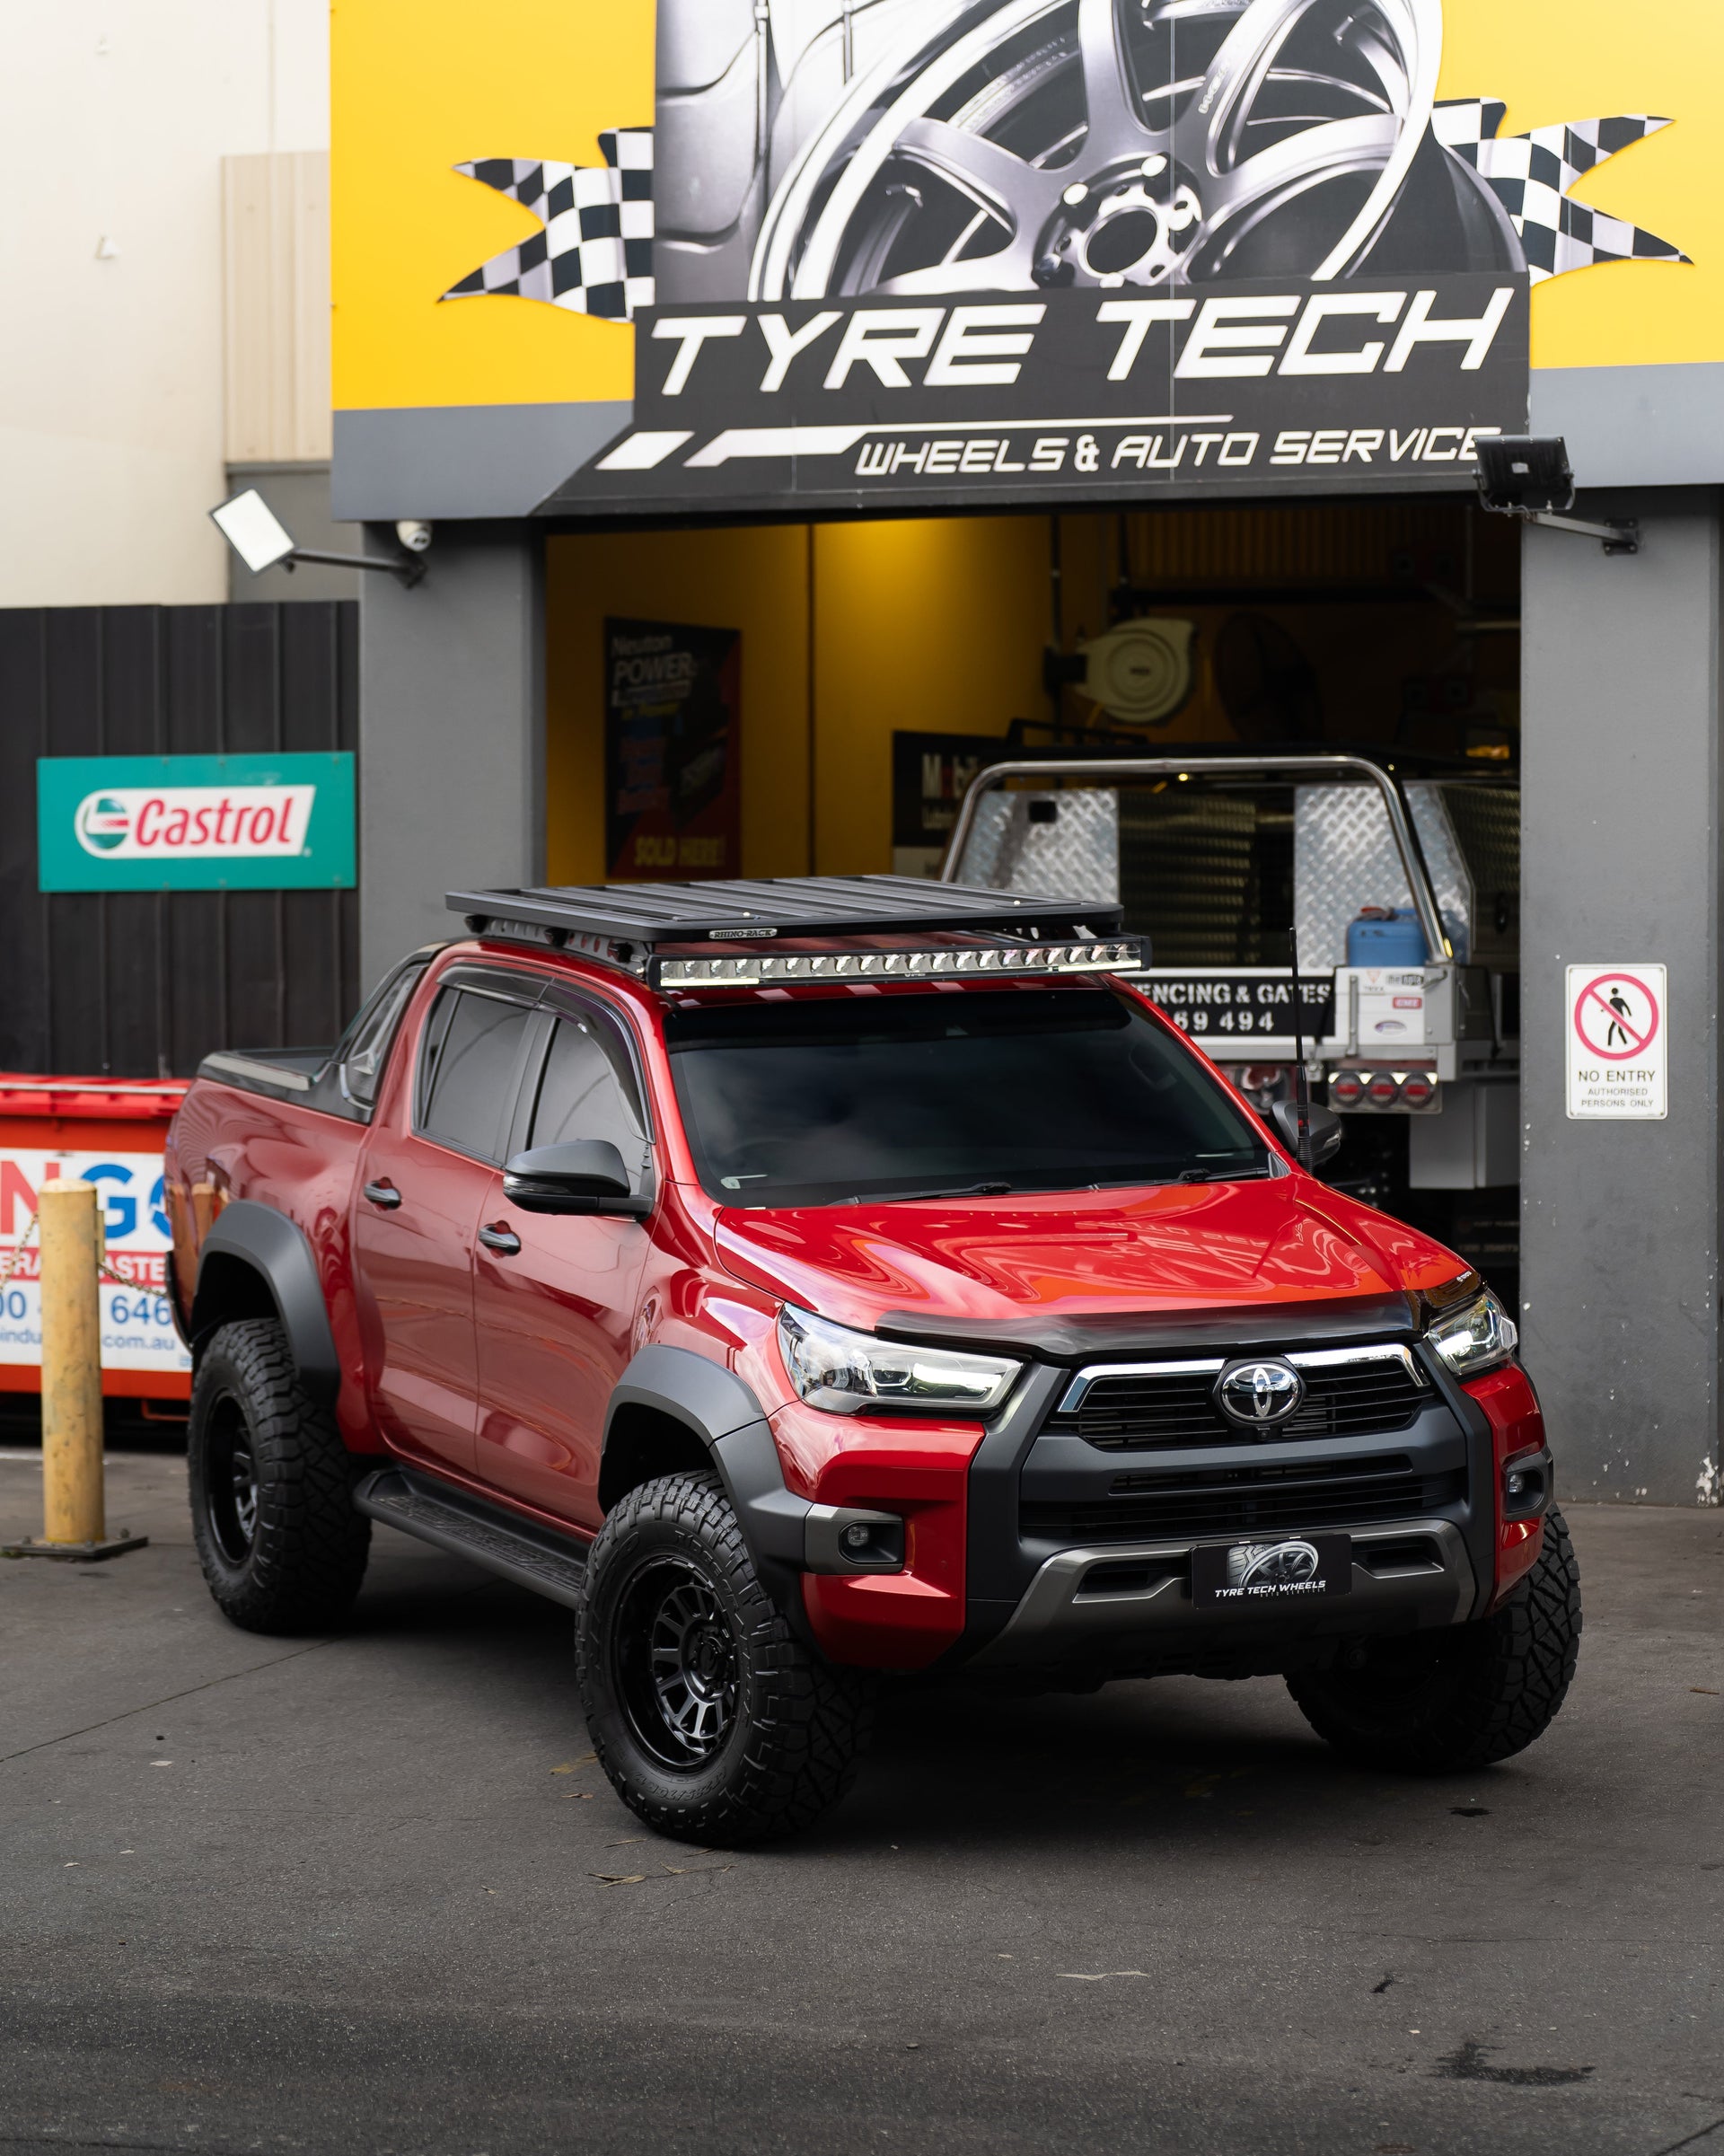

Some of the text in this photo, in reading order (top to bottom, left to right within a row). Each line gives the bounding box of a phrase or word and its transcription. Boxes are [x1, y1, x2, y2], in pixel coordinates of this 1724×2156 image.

[651, 287, 1514, 395] TYRE TECH
[855, 437, 1069, 475] WHEELS
[1074, 435, 1100, 472] &
[1111, 432, 1260, 469] AUTO
[136, 797, 294, 847] Castrol
[714, 929, 771, 938] RHINO-RACK
[1131, 983, 1231, 1004] ENCING
[1236, 984, 1251, 1004] &
[1165, 1010, 1274, 1032] 69 494
[1579, 1070, 1656, 1082] NO ENTRY
[1588, 1087, 1649, 1096] AUTHORISED
[1630, 1099, 1654, 1107] ONLY
[99, 1254, 165, 1281] ASTE
[111, 1295, 172, 1326] 646
[1215, 1580, 1326, 1598] TYRE TECH WHEELS
